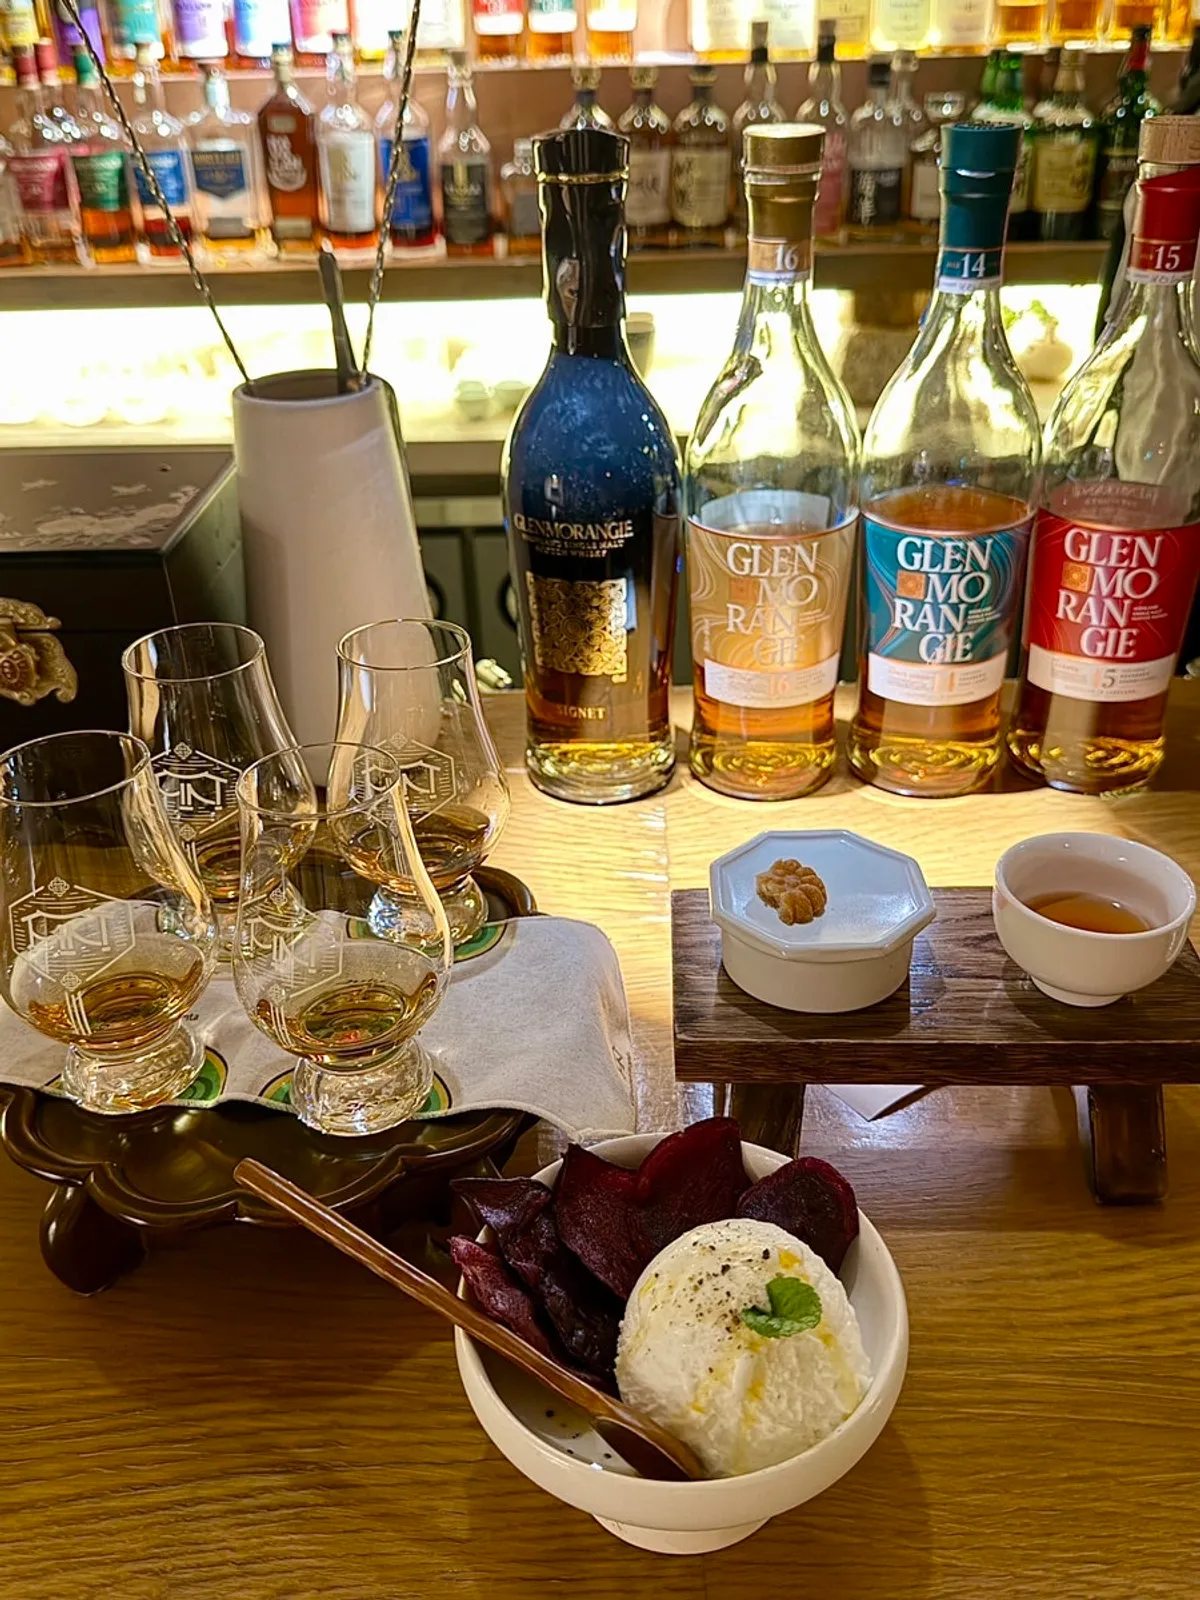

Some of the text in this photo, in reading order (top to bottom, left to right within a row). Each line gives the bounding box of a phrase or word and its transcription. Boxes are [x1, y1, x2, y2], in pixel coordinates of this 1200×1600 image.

[775, 244, 799, 271] 16
[960, 253, 986, 278] 14
[1154, 245, 1181, 270] 15
[726, 541, 820, 577] GLEN
[896, 537, 993, 573] GLEN
[1064, 527, 1164, 568] GLEN
[757, 574, 819, 606] MO
[926, 571, 991, 603] MO
[1089, 563, 1161, 599] MO
[726, 604, 800, 635] RAN
[892, 598, 967, 633] RAN
[1056, 589, 1133, 628] RAN
[919, 631, 974, 664] GIE
[1080, 626, 1140, 658] GIE
